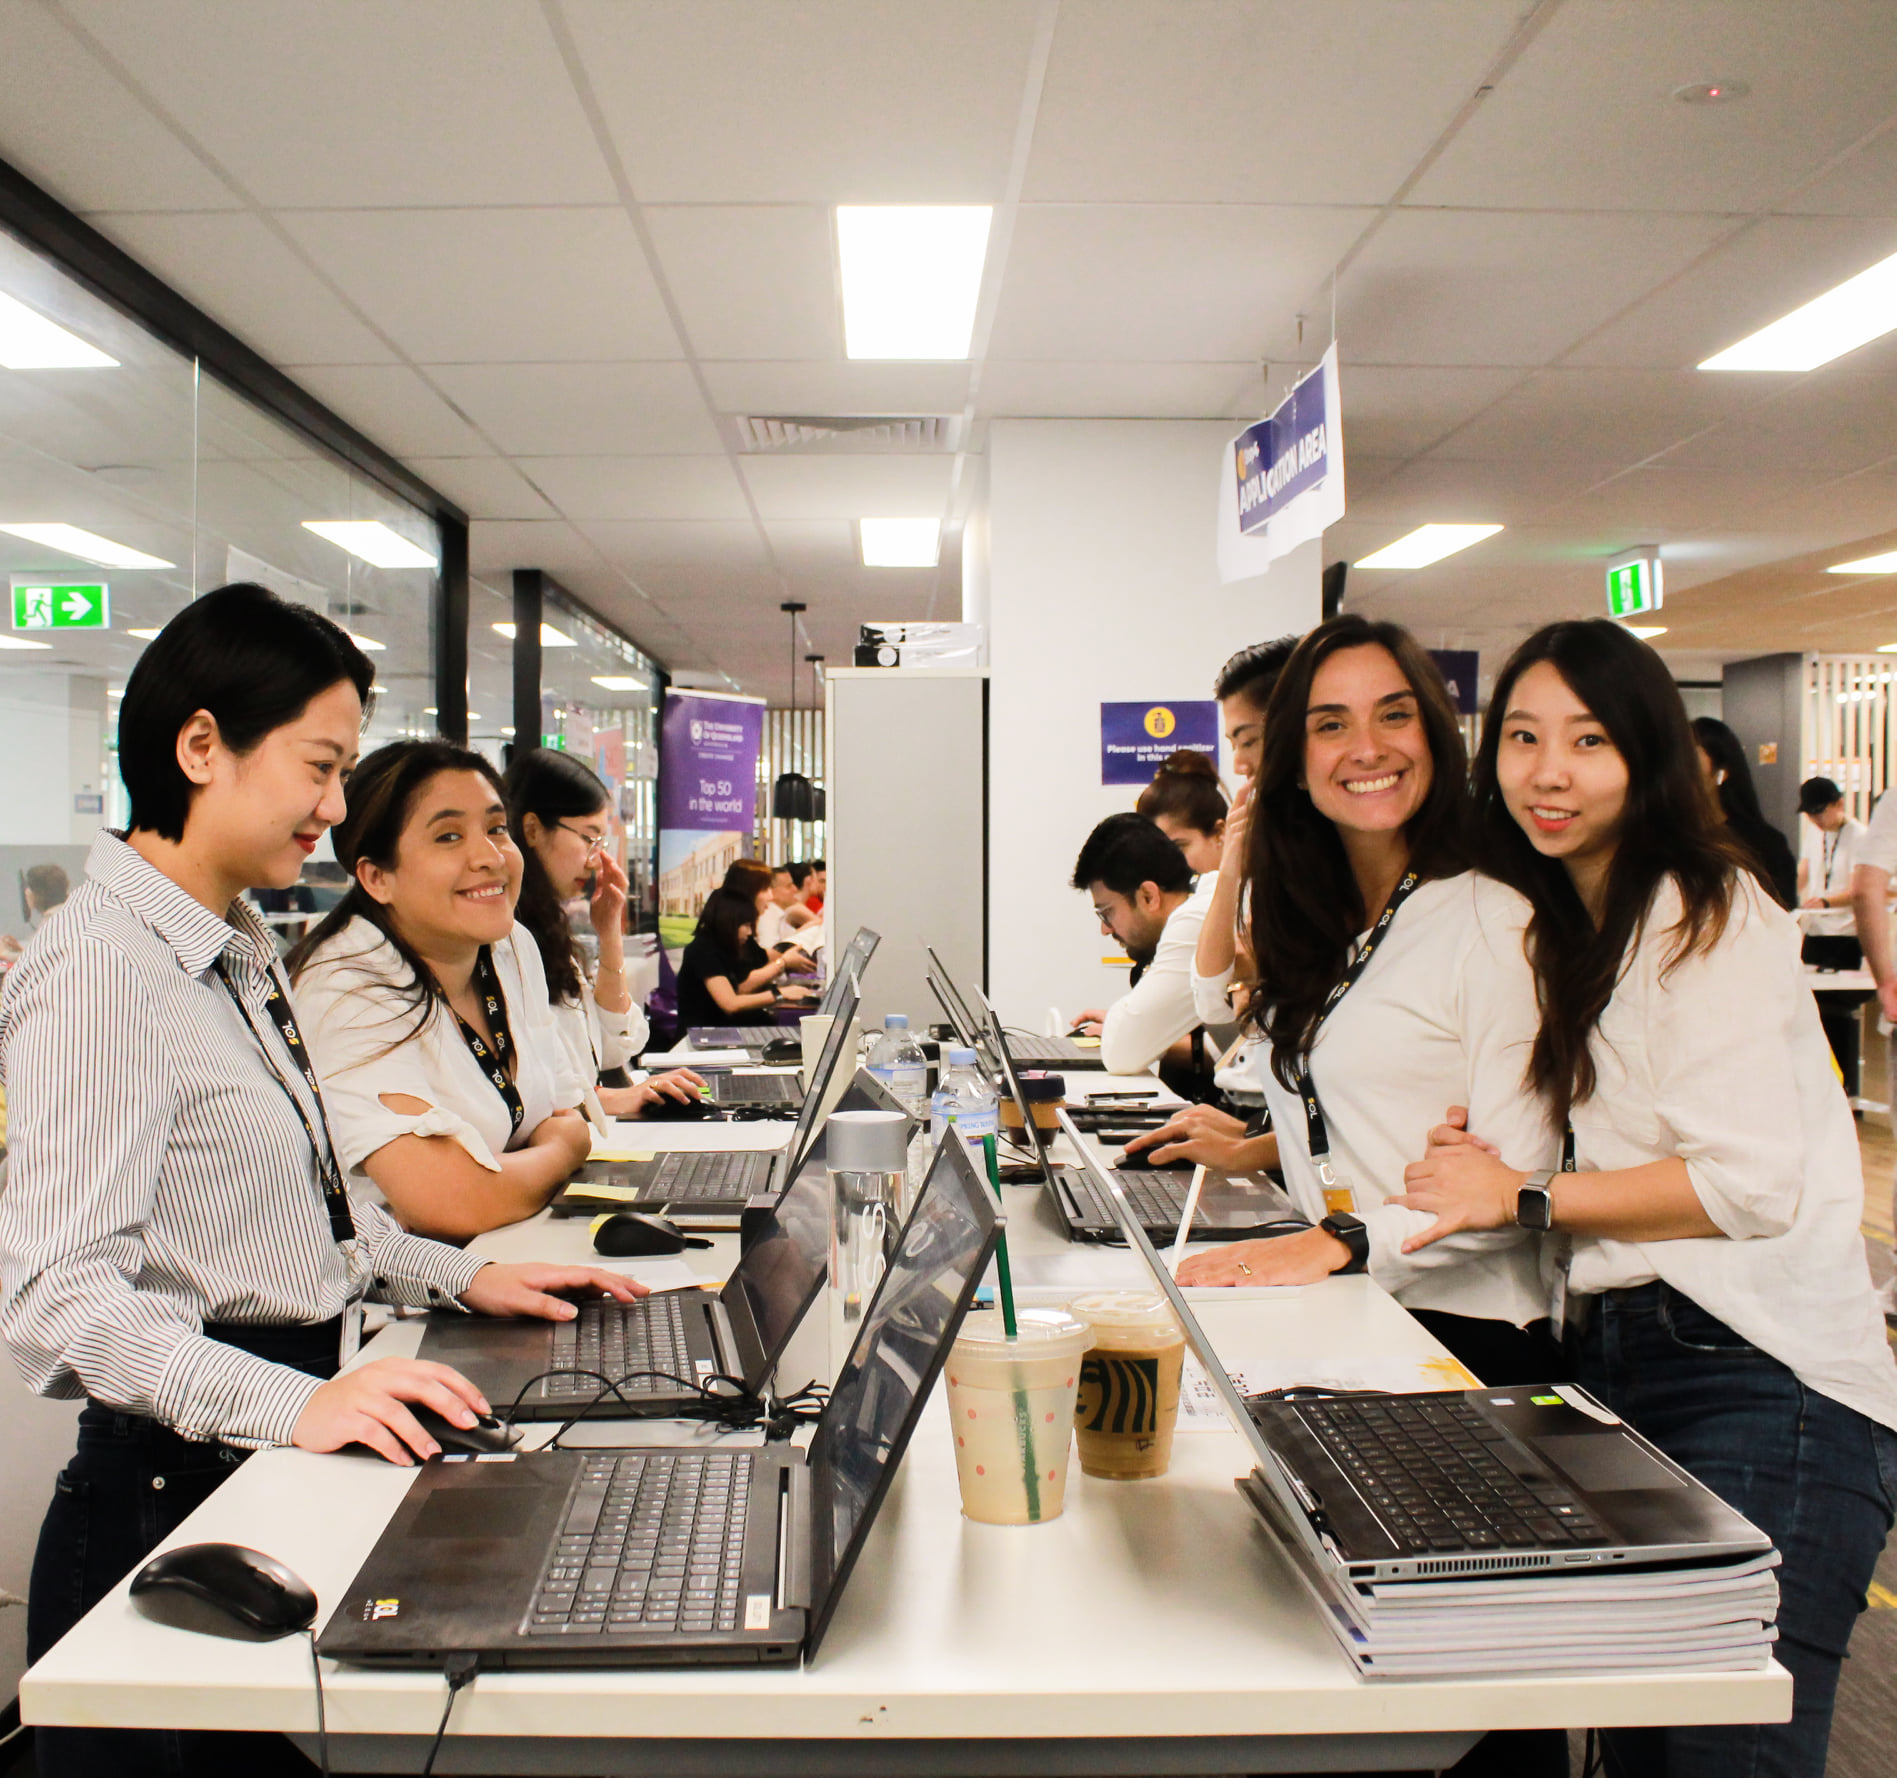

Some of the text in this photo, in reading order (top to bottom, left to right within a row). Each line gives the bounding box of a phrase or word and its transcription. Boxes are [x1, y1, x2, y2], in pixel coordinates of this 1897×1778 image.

[1239, 444, 1298, 515] APPLICATION
[1298, 423, 1327, 472] AREA
[1107, 744, 1136, 754] Please
[1137, 746, 1153, 754] use
[1153, 743, 1177, 753] hand
[1147, 753, 1163, 762] this
[699, 779, 732, 796] Top 50
[689, 797, 743, 813] in the world
[486, 995, 499, 1016] SOL
[282, 1020, 300, 1045] SOL
[471, 1037, 487, 1057] SOL
[492, 1068, 506, 1090] SOL
[1307, 1097, 1318, 1119] SOL
[1565, 1156, 1574, 1172] OL
[371, 1598, 400, 1621] SOL
